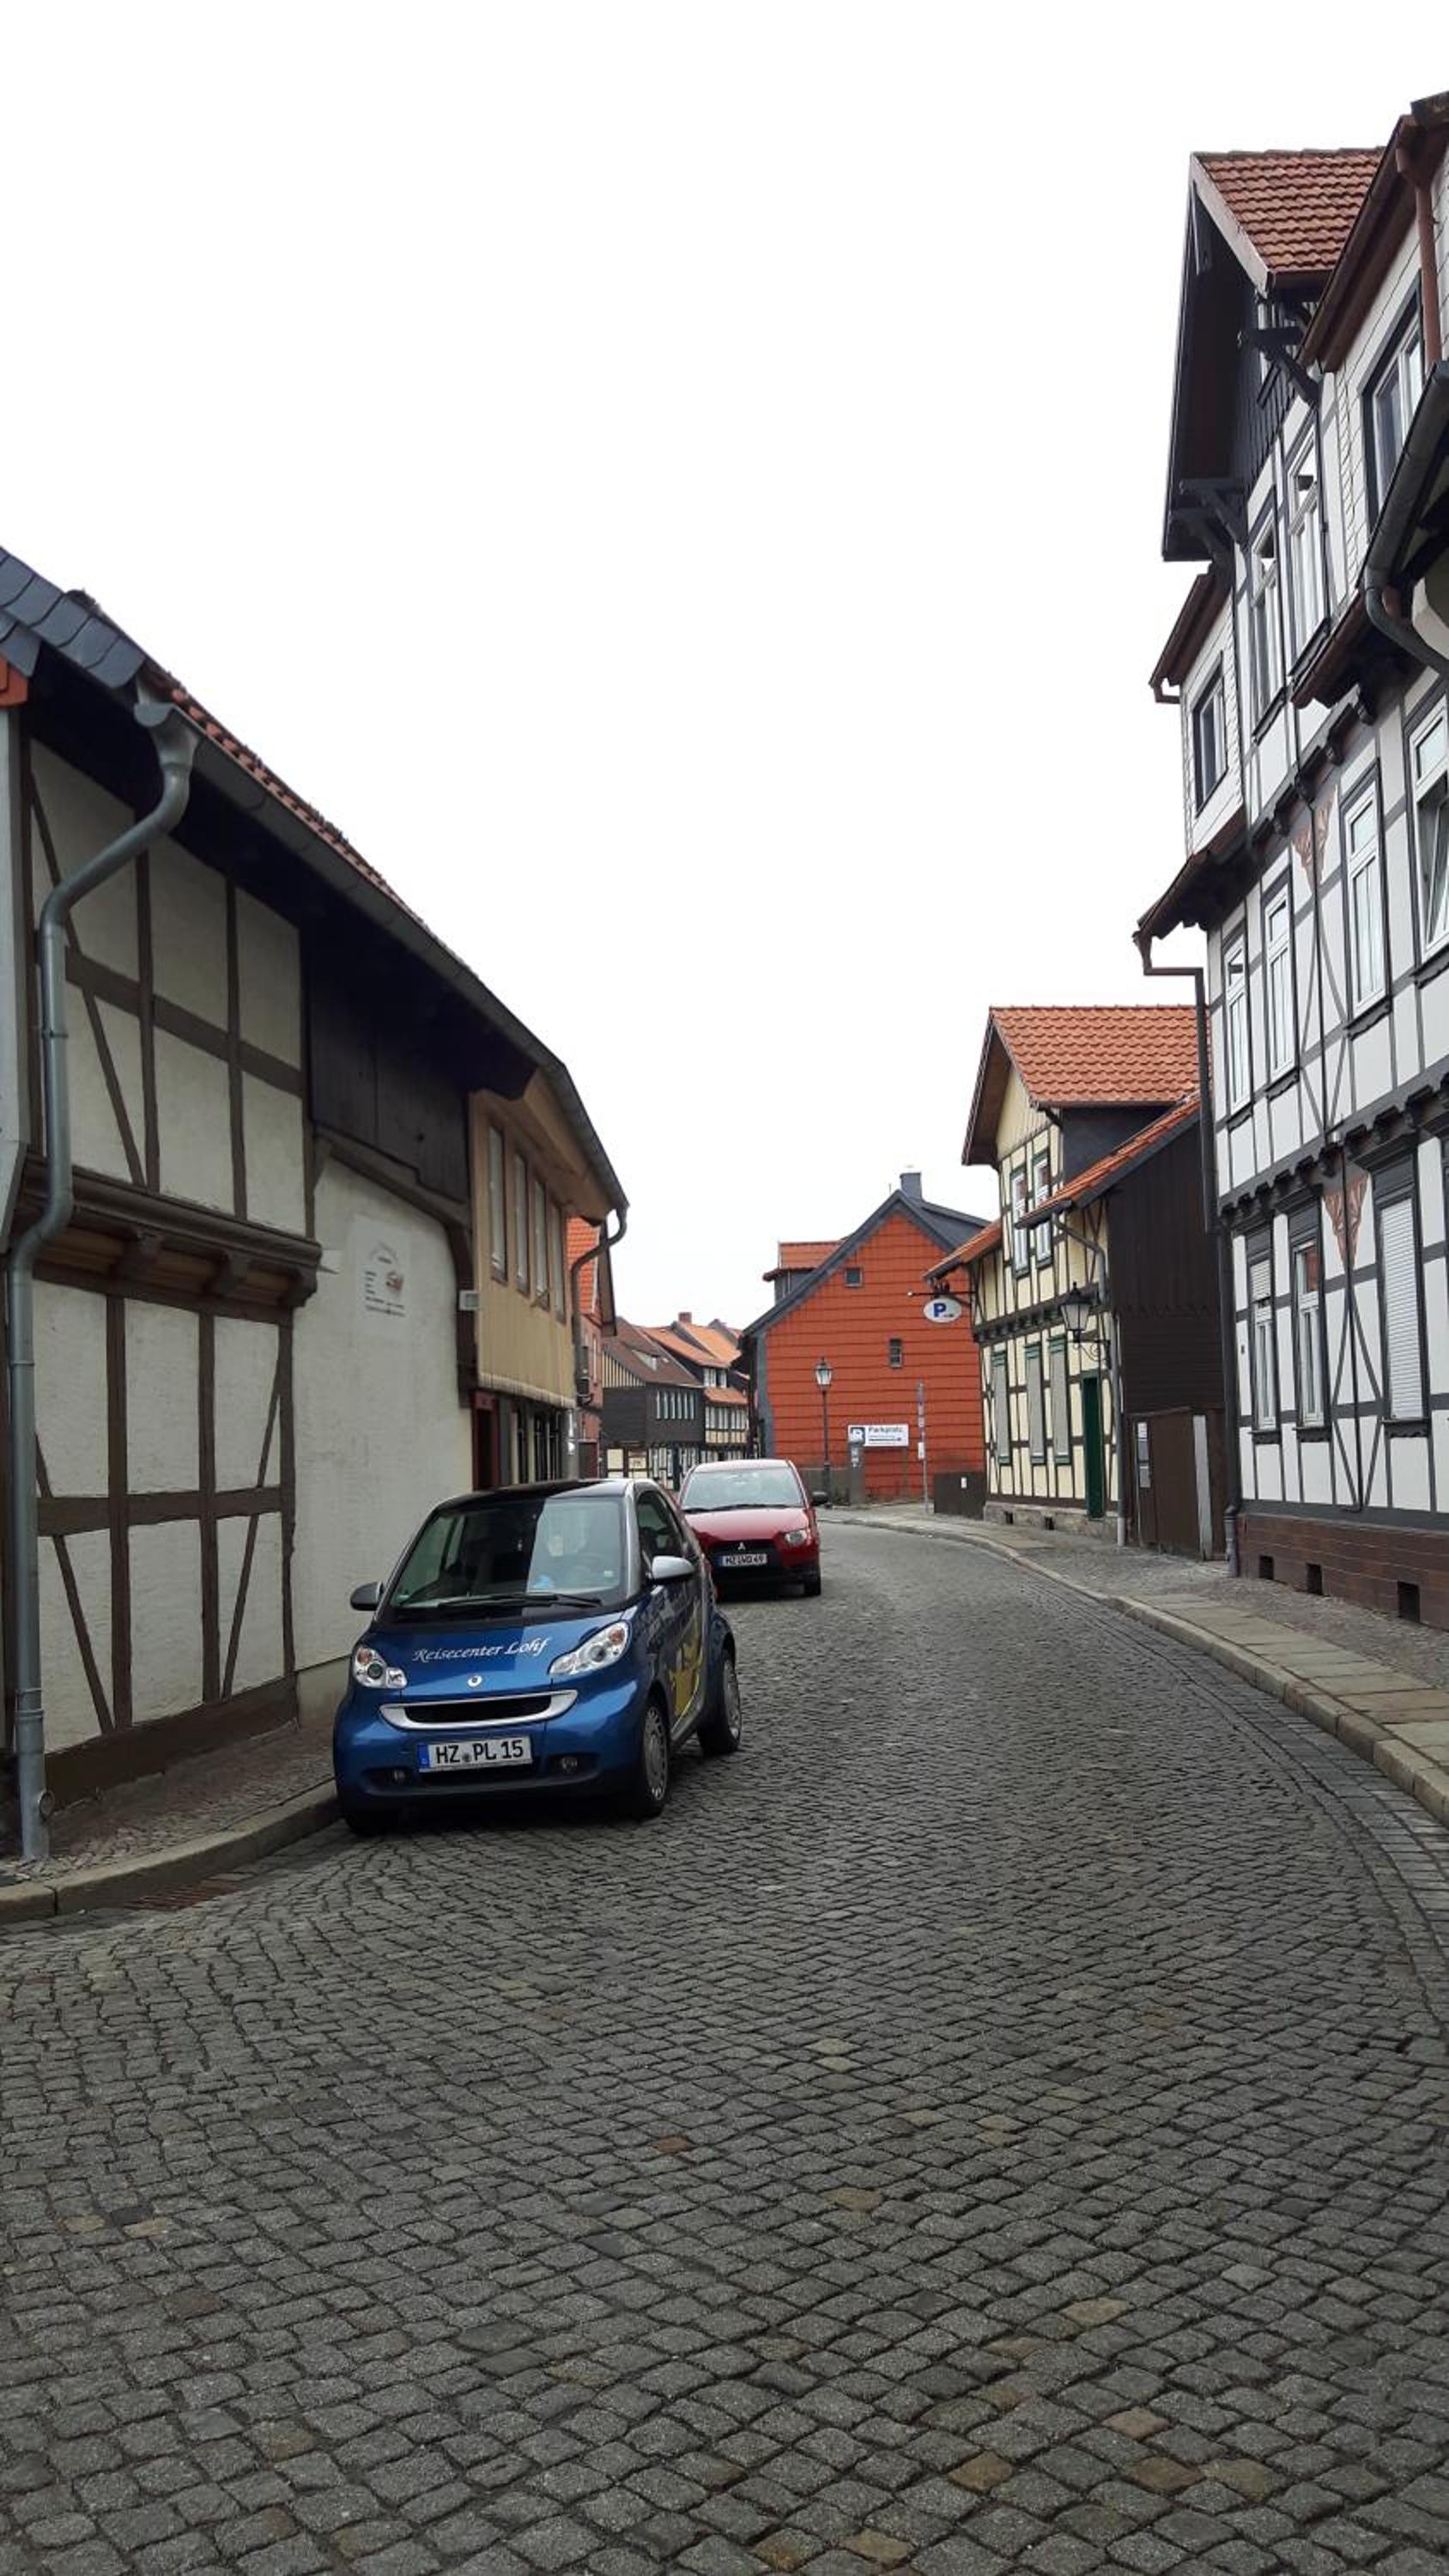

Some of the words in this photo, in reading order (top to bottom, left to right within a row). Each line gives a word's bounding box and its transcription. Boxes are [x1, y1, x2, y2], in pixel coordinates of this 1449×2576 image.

[934, 1303, 947, 1317] P
[412, 1646, 504, 1662] Reisecenter
[435, 1744, 460, 1764] HZ
[472, 1742, 497, 1761] PL
[500, 1739, 524, 1759] 15
